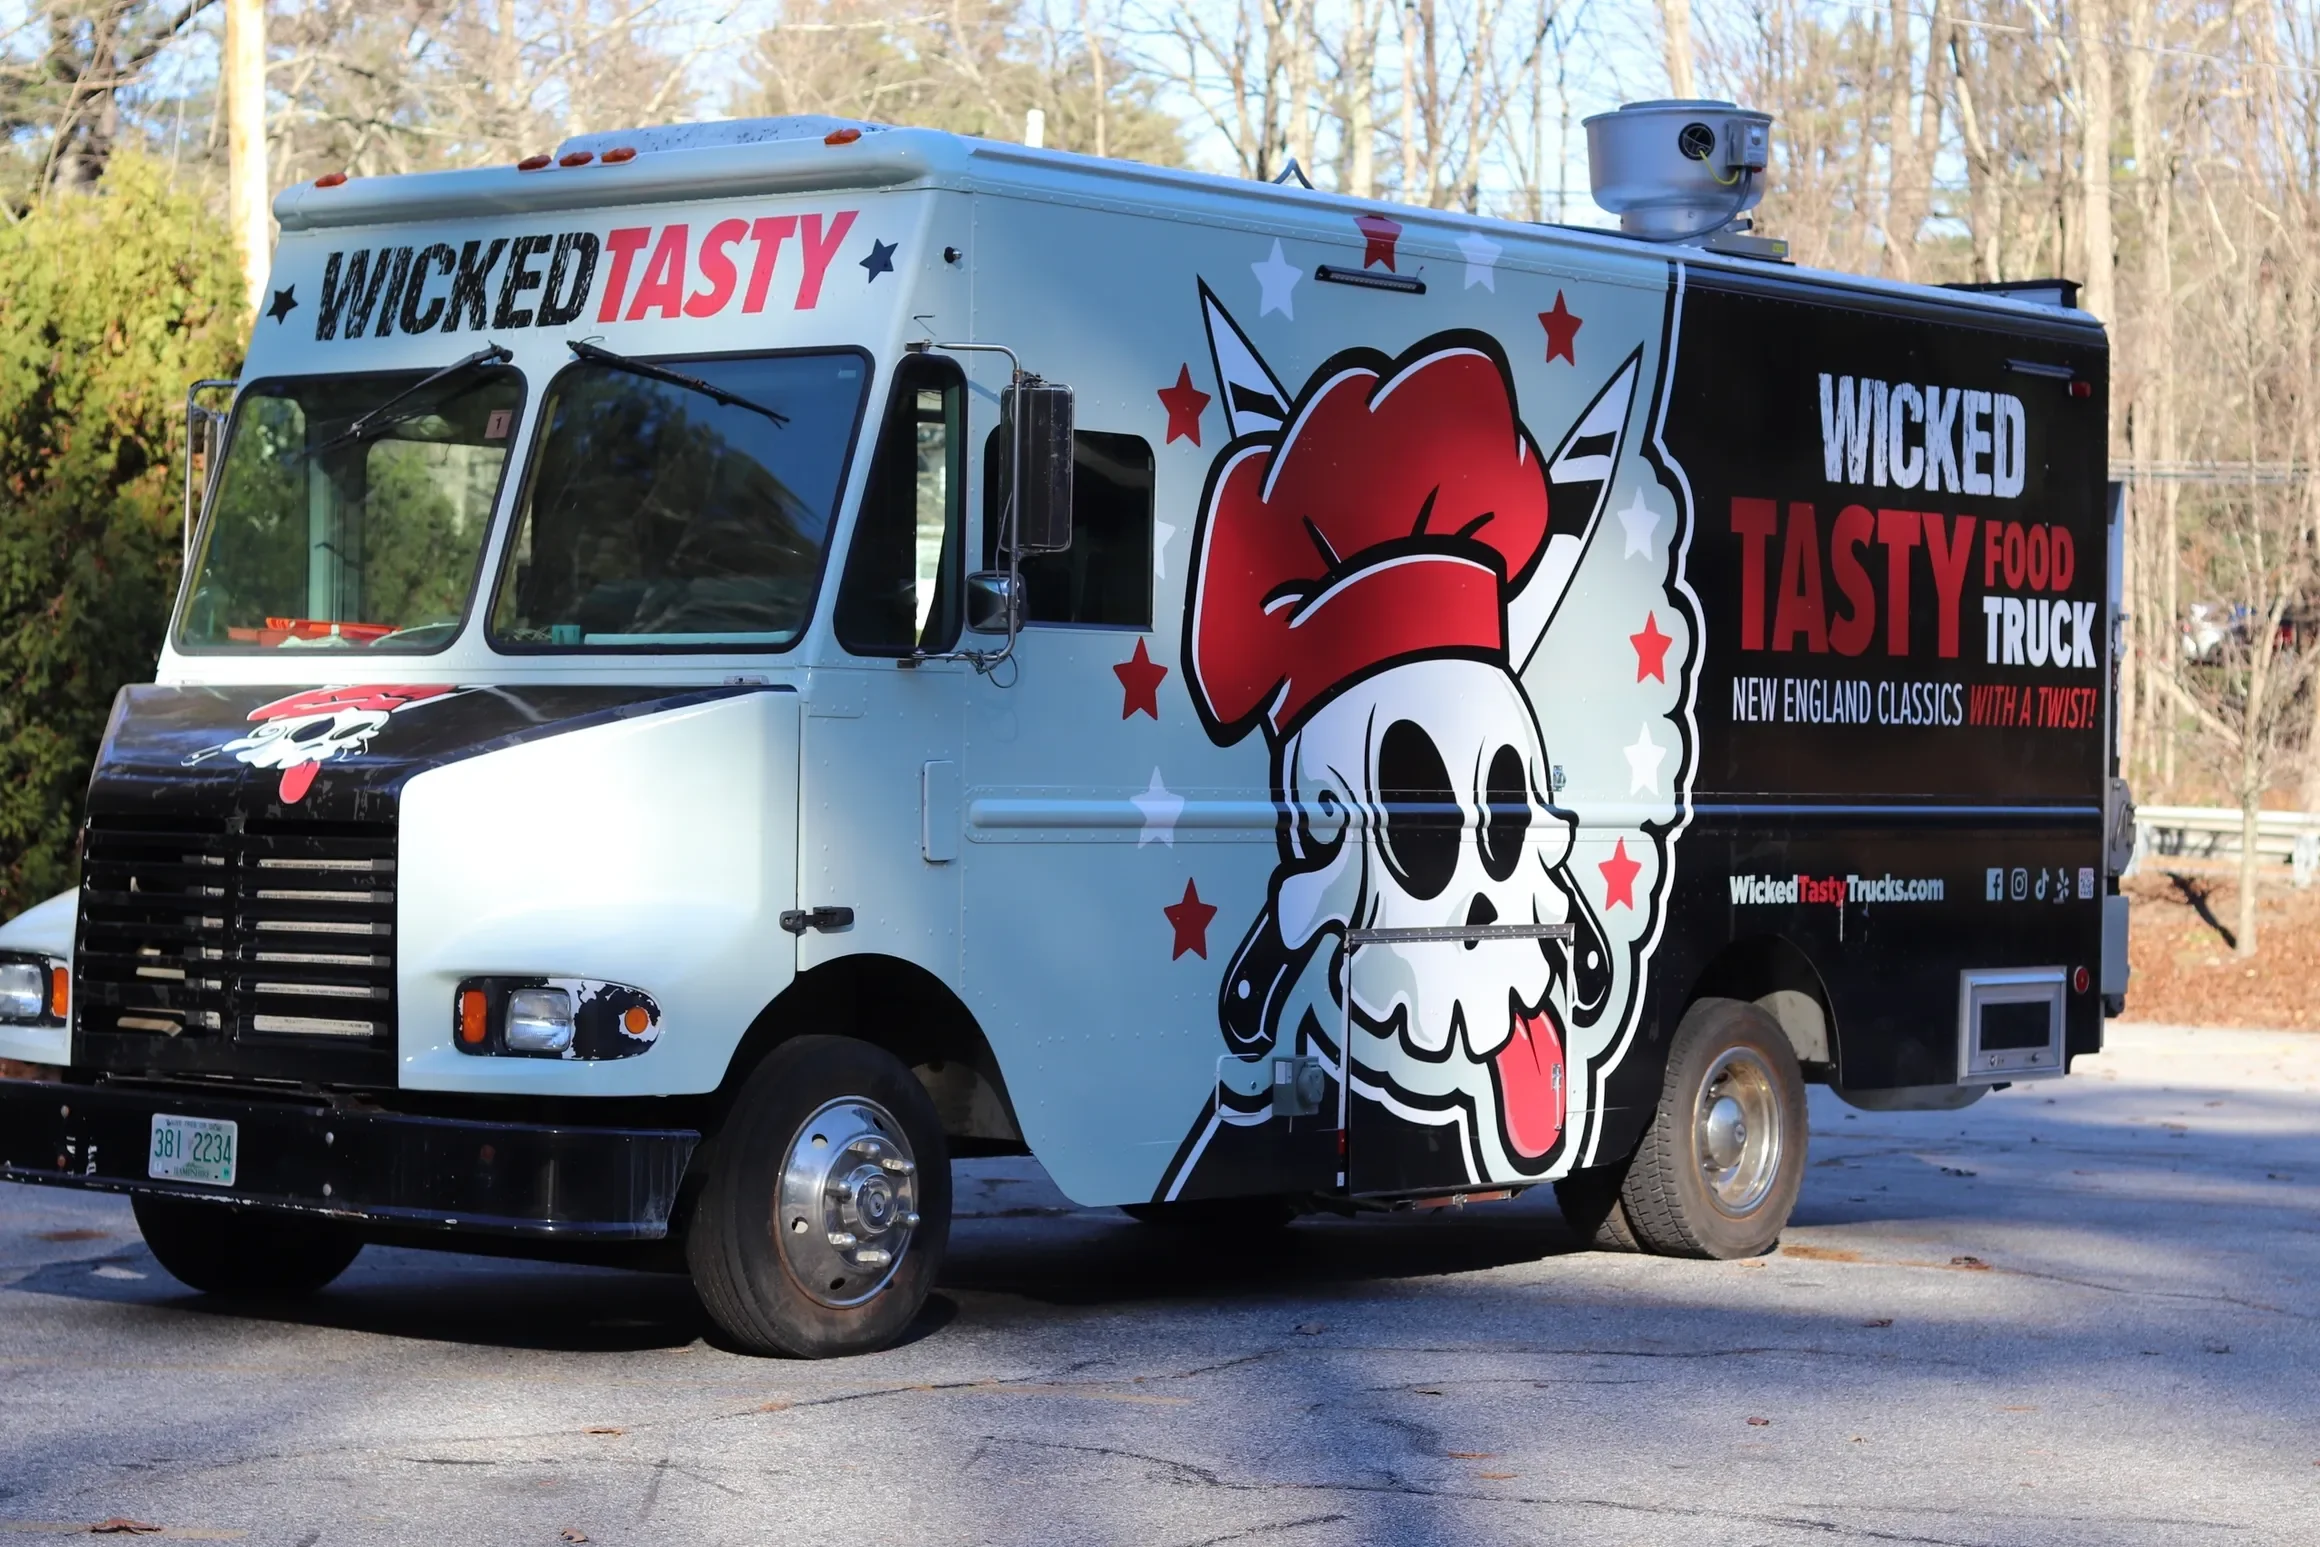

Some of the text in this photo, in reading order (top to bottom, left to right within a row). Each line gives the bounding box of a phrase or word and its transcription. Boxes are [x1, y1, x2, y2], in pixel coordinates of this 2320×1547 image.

[1818, 372, 2026, 498] WICKED
[1731, 496, 1977, 658] TASTY
[1985, 519, 2075, 592] FOOD
[1983, 596, 2097, 668] TRUCK
[1732, 676, 2097, 729] NEW ENGLAND CLASSICS WITH A TWIST!
[1729, 873, 1944, 907] WickedTastyTrucks.com
[154, 1128, 232, 1165] 381 2234
